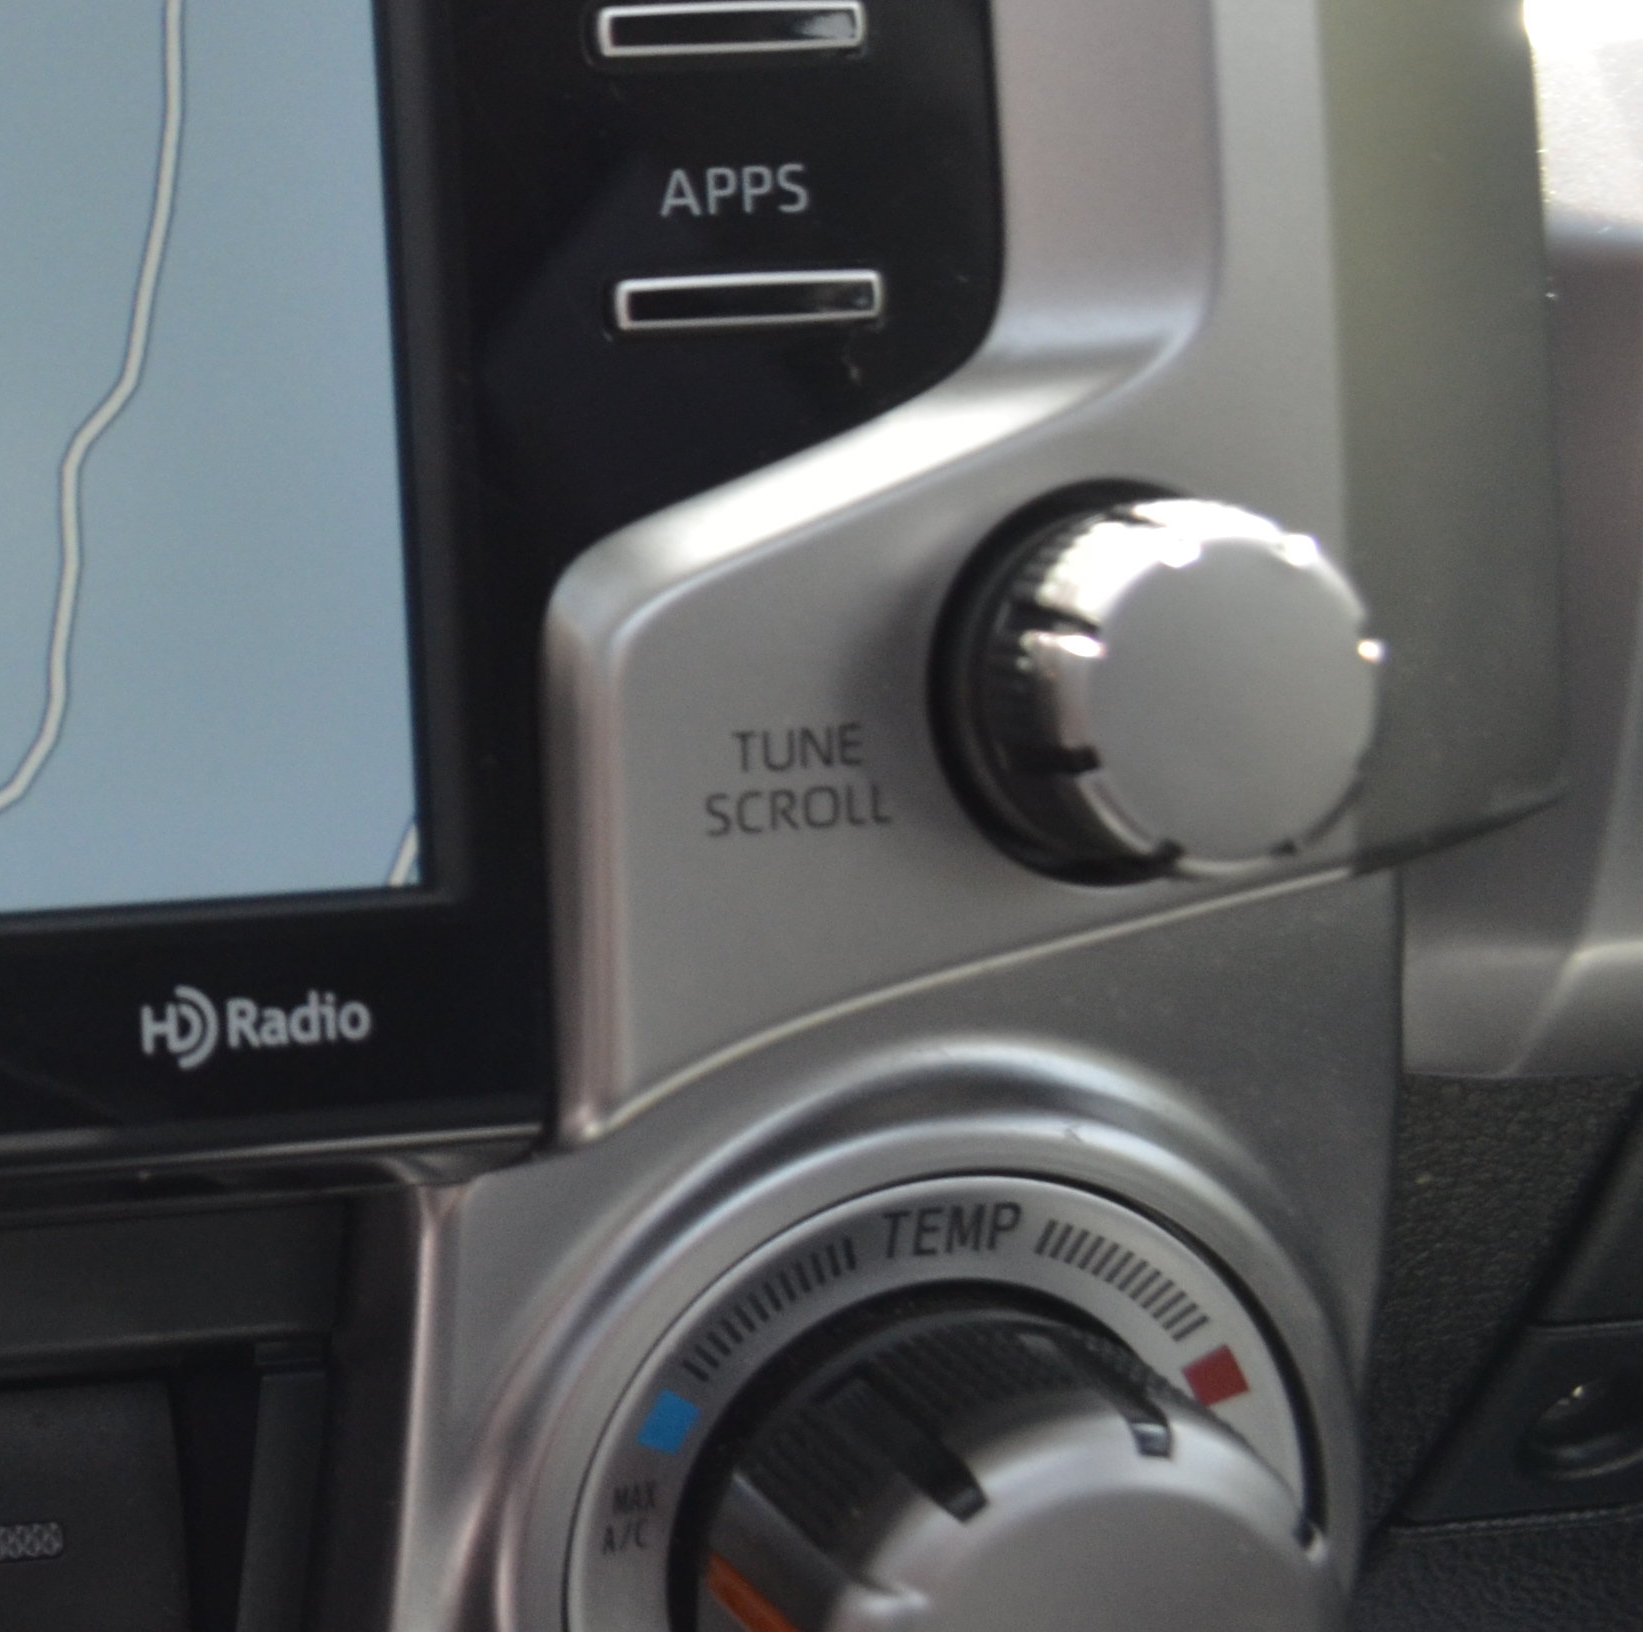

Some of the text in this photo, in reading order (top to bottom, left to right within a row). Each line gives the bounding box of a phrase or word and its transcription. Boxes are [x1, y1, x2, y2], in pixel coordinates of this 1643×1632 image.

[660, 163, 810, 218] APPS
[732, 724, 864, 774] TUNE
[704, 781, 893, 838] SCROLL
[226, 991, 372, 1050] Radio
[881, 1201, 1023, 1259] TEMP
